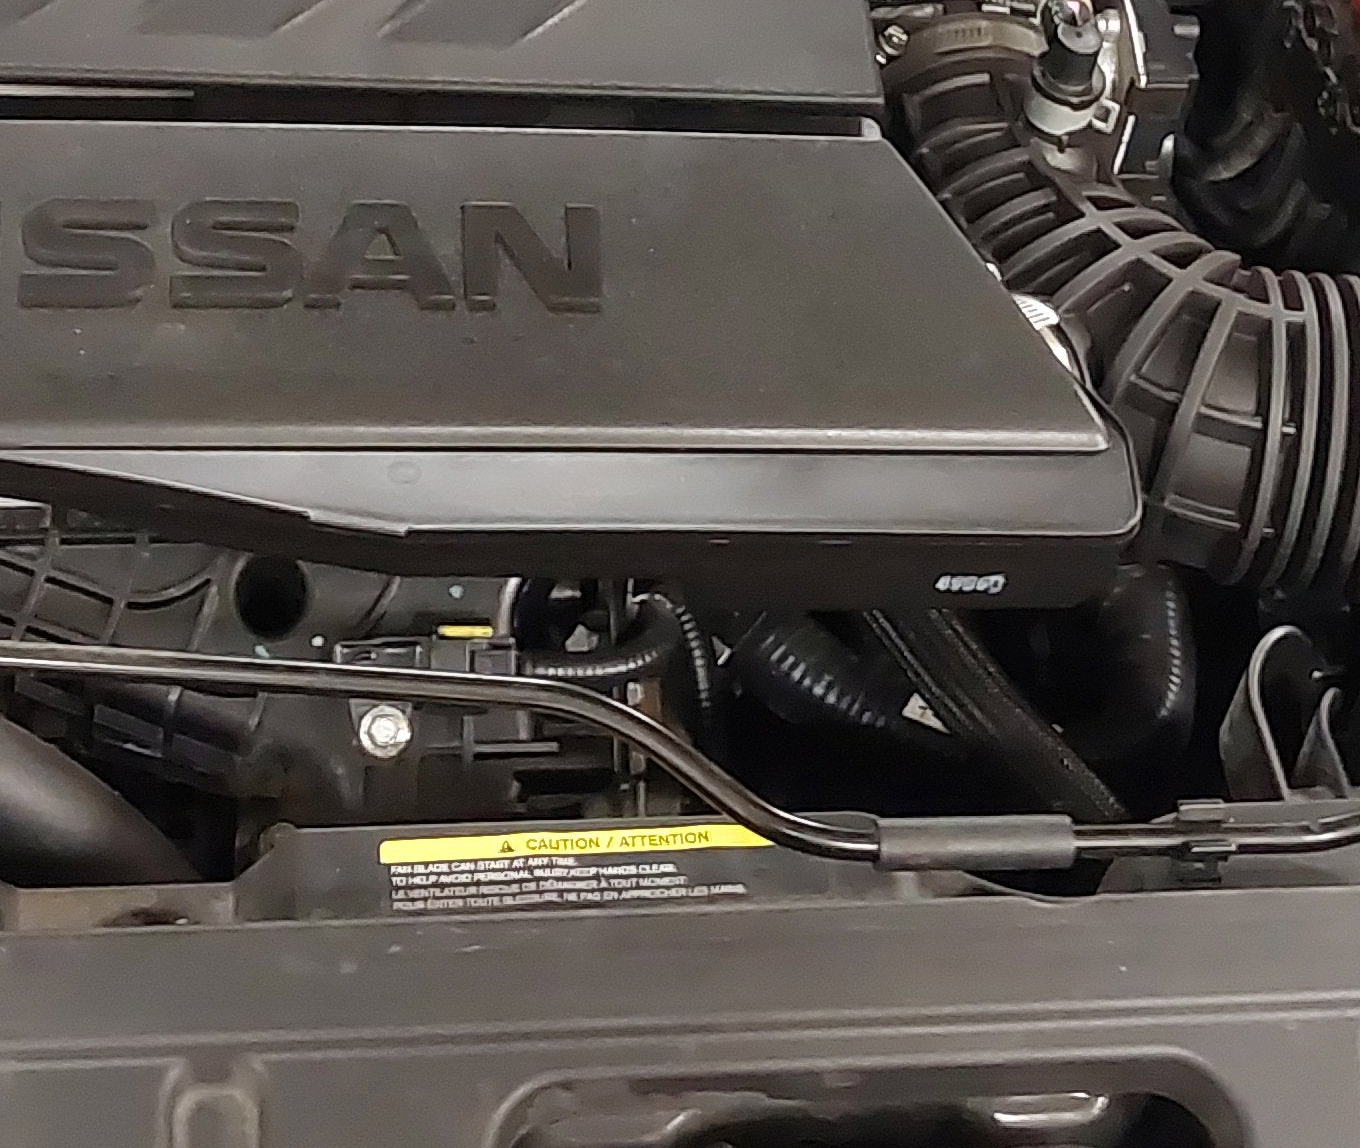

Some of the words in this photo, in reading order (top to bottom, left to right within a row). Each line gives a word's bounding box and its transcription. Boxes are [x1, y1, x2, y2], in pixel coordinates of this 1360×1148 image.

[526, 837, 600, 851] CAUTION
[606, 836, 614, 849] /
[620, 830, 710, 847] ATTENTION
[452, 861, 475, 872] CAN
[476, 859, 511, 871] START
[512, 858, 525, 868] AT
[391, 876, 406, 886] TO
[408, 874, 437, 885] HELP
[438, 873, 470, 884] AVOID
[473, 870, 533, 883] PERSONAL
[609, 877, 638, 888] TOUT
[466, 896, 501, 907] TOUTE
